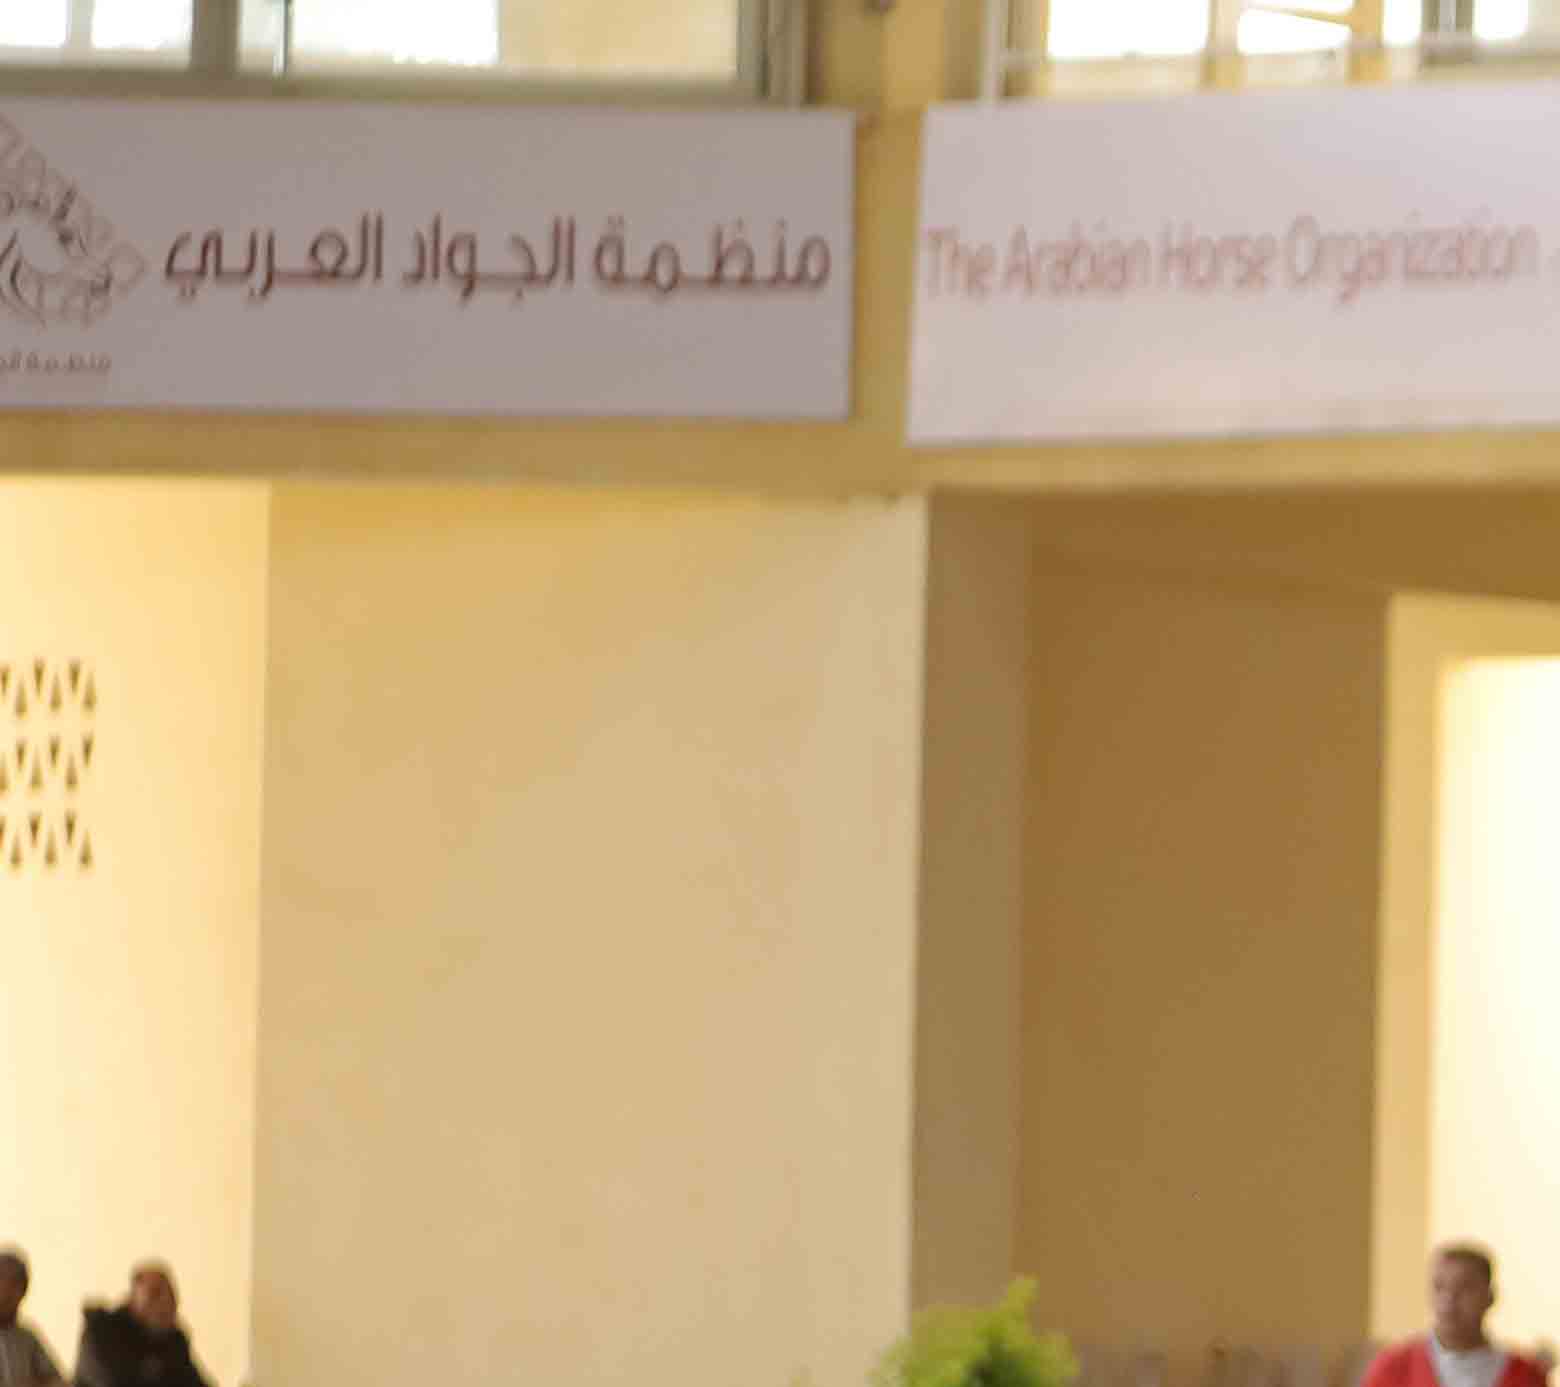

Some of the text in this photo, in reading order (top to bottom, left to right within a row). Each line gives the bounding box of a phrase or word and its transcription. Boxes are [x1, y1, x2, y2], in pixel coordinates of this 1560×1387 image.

[163, 208, 832, 308] منظمة الجواد العربي
[922, 206, 1542, 312] The Arabian Horse Organization
